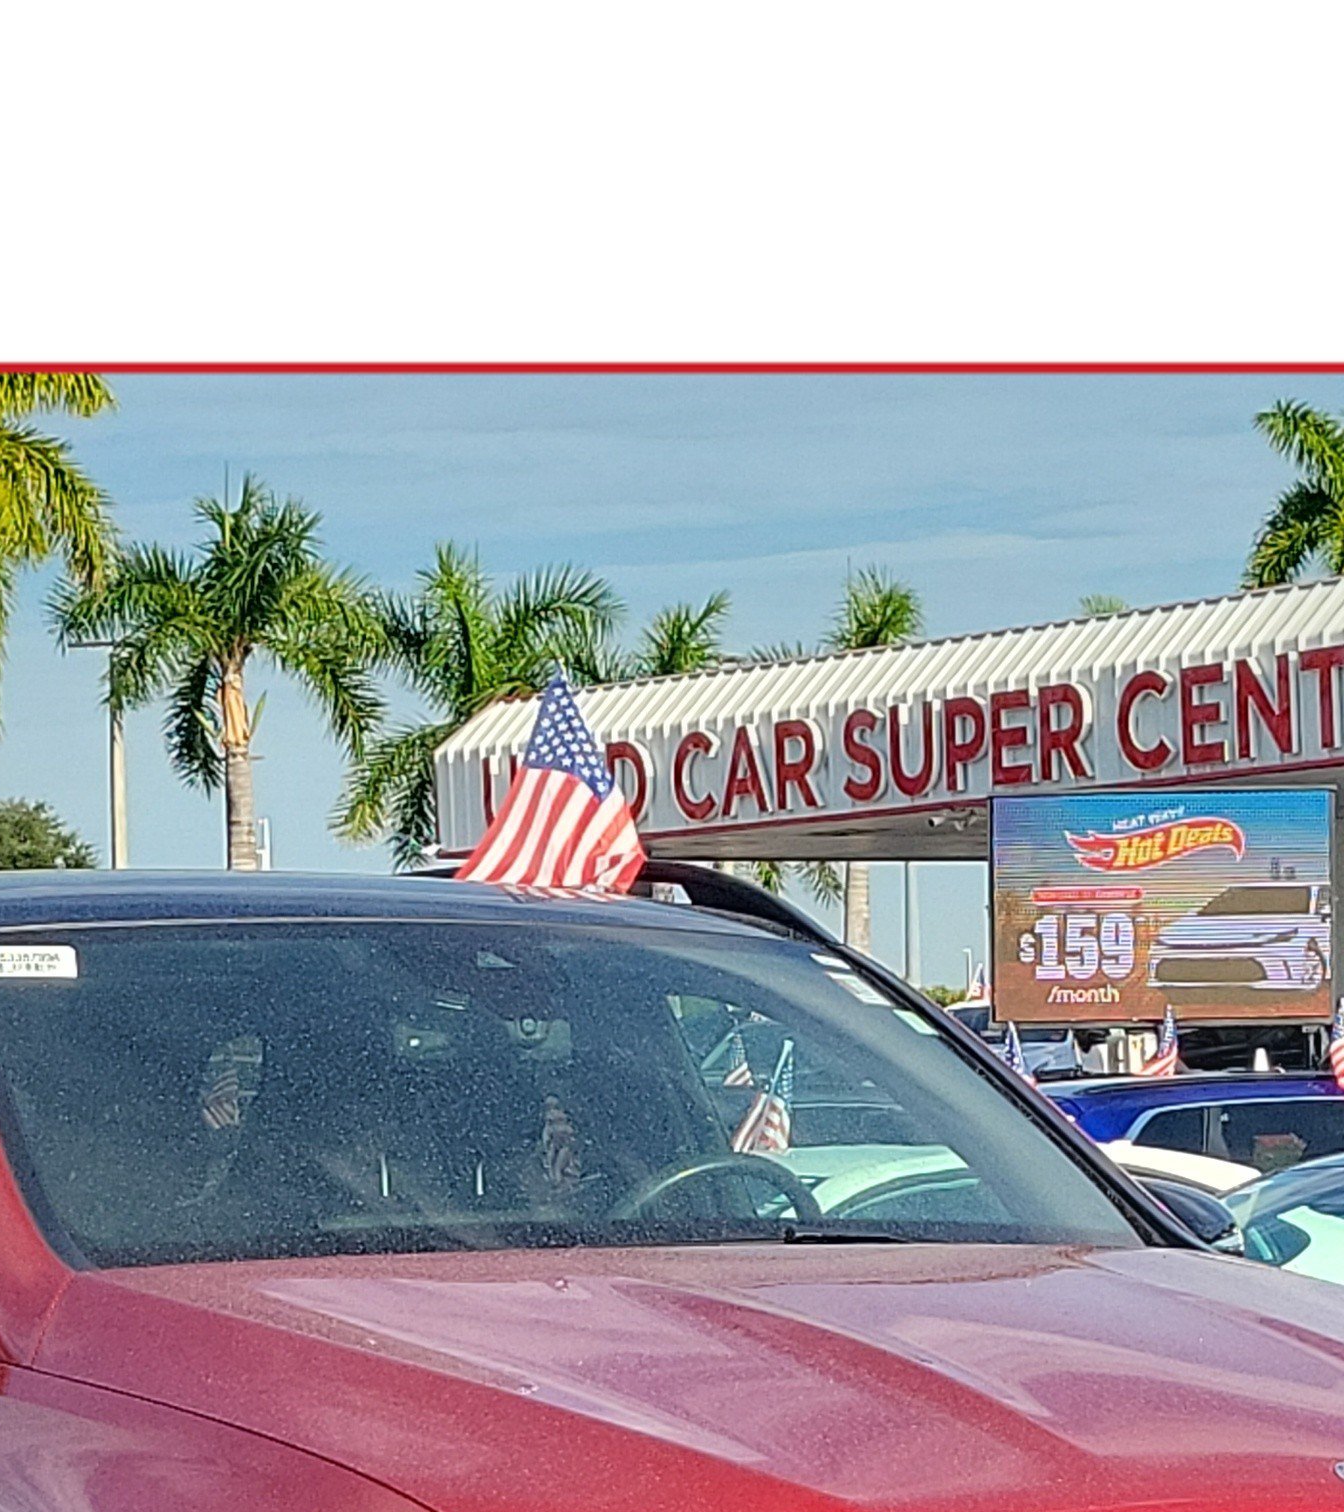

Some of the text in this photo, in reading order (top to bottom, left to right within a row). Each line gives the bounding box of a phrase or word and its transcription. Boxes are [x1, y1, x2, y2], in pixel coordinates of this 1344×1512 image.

[672, 717, 826, 822] CAR
[841, 682, 1097, 803] SUPER
[1112, 822, 1234, 867] Hot Deals
[1018, 912, 1136, 981] $159
[1047, 985, 1120, 1003] /month
